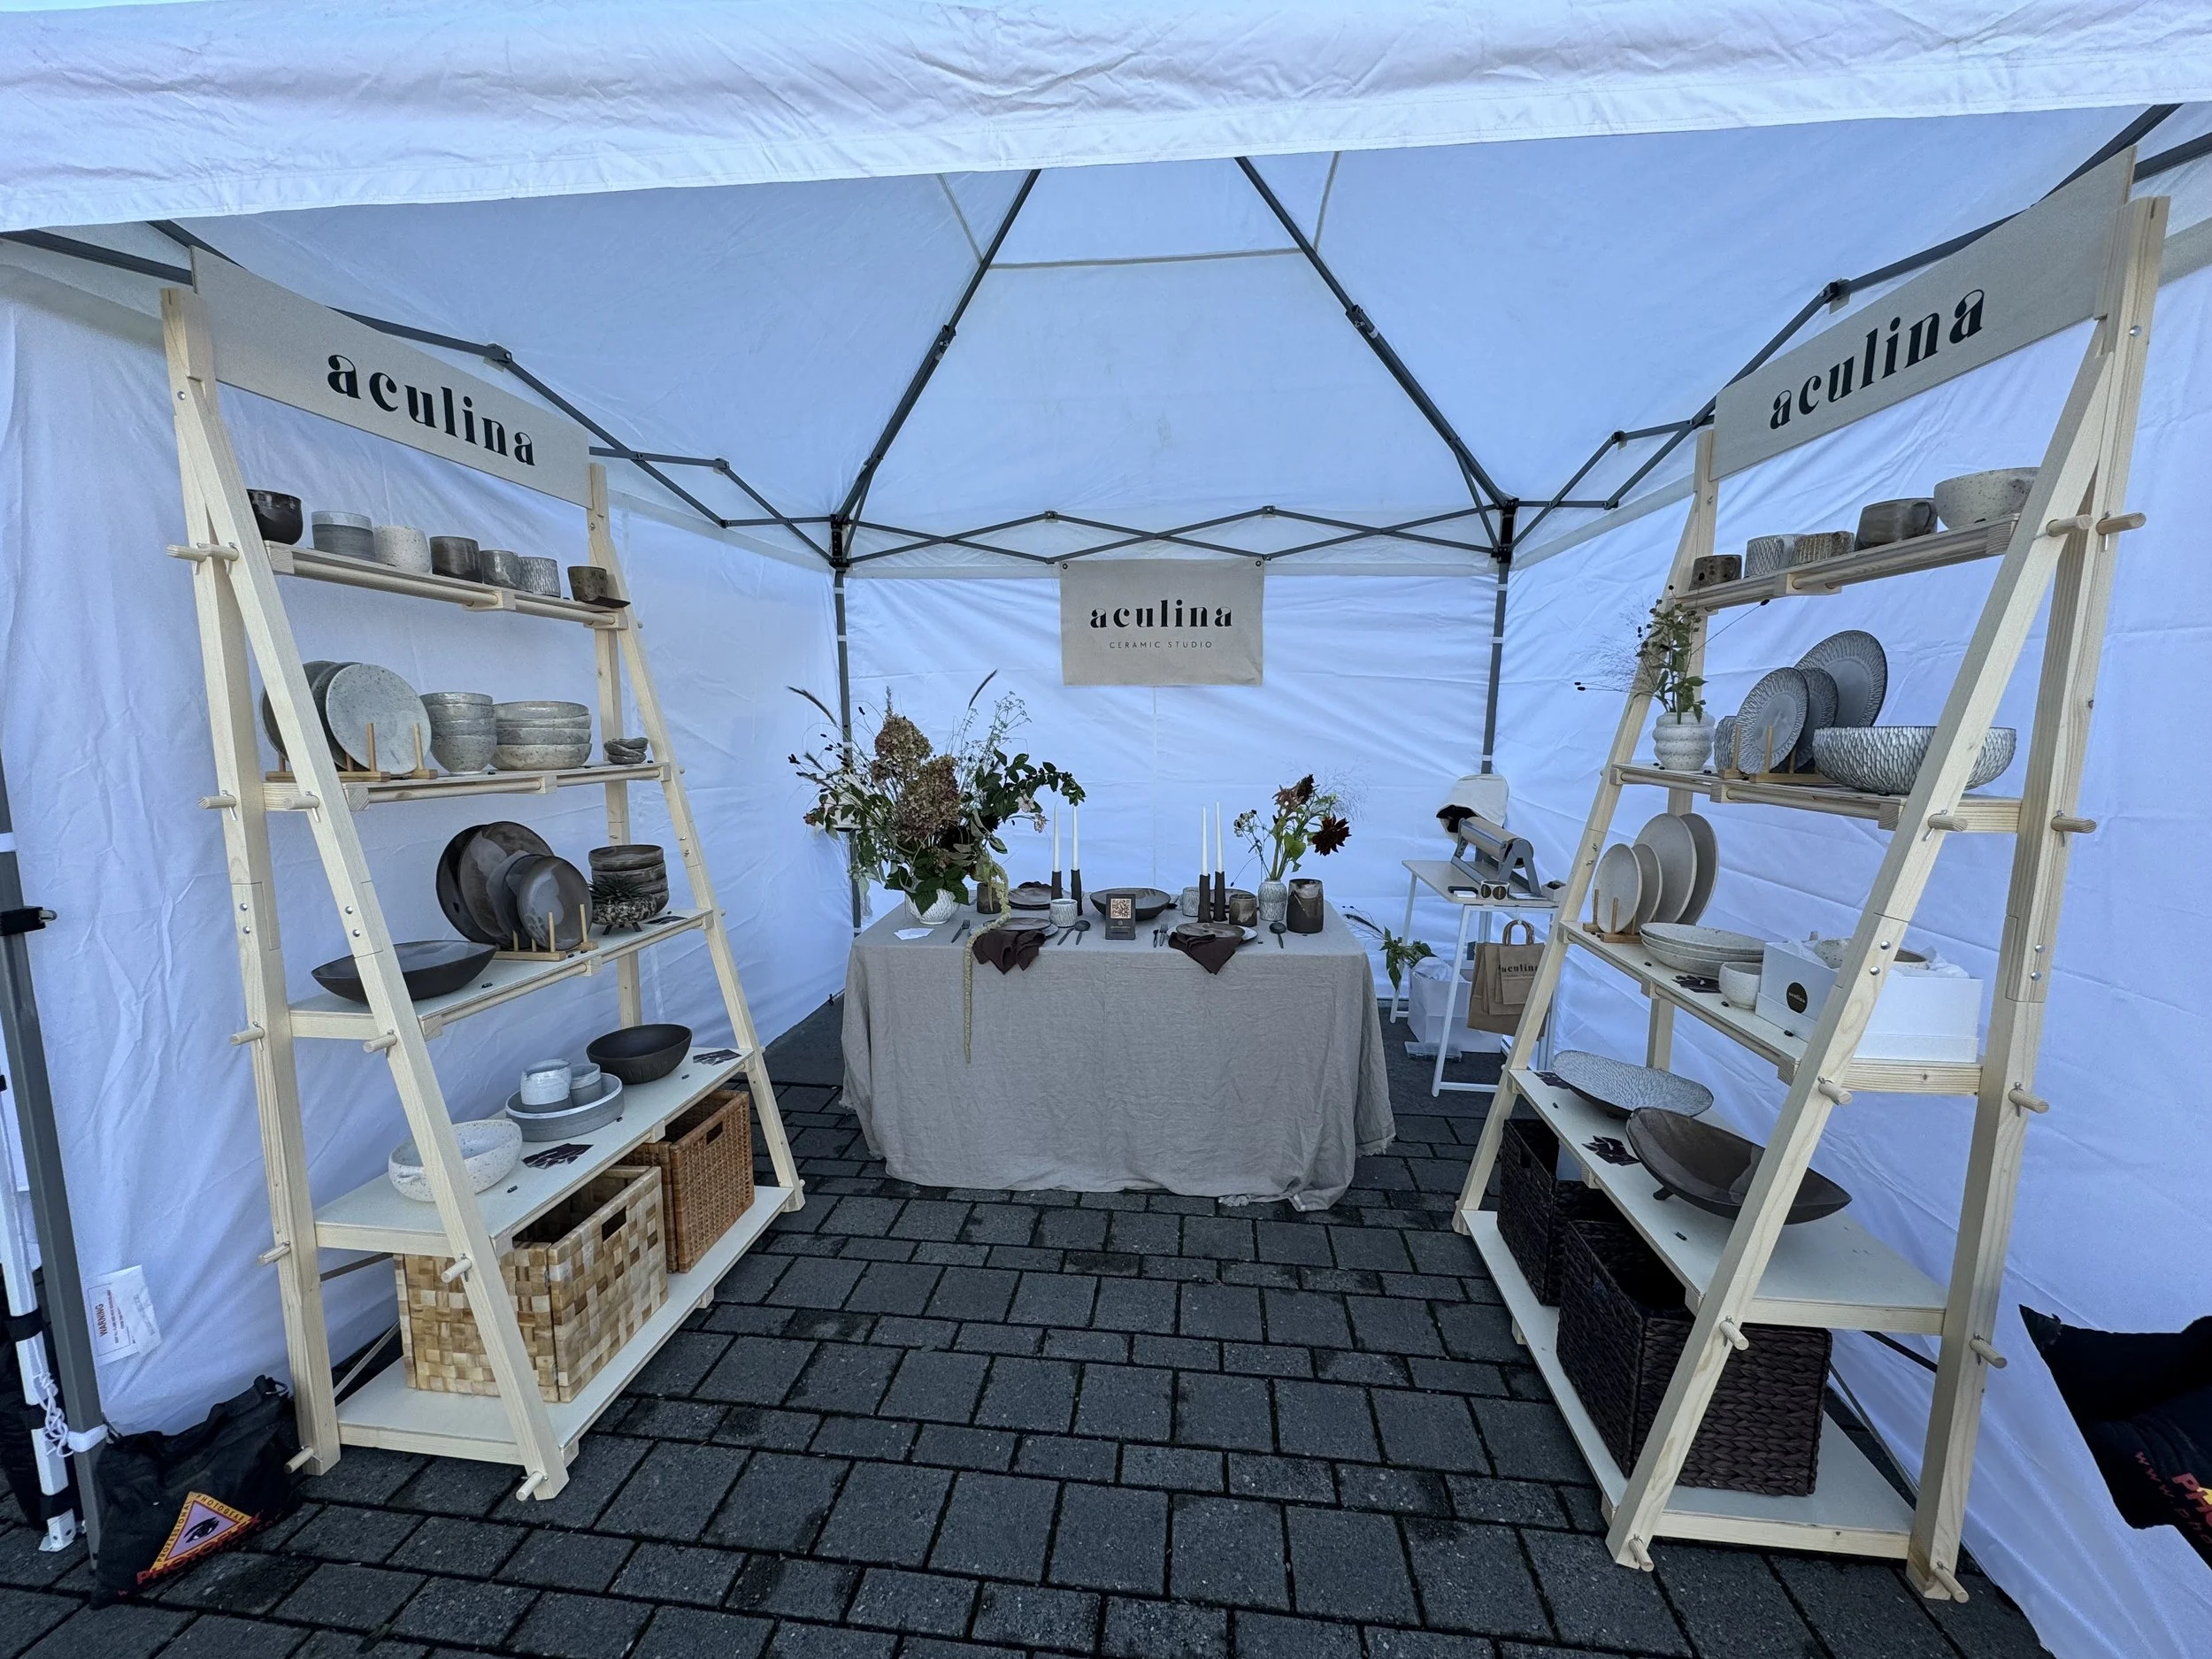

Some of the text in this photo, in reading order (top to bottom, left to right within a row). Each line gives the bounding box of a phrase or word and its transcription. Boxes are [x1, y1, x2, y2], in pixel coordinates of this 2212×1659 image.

[1770, 288, 1985, 429] aculina
[327, 354, 535, 466] aculina
[1090, 599, 1233, 628] aculina
[95, 1303, 108, 1337] WARNING
